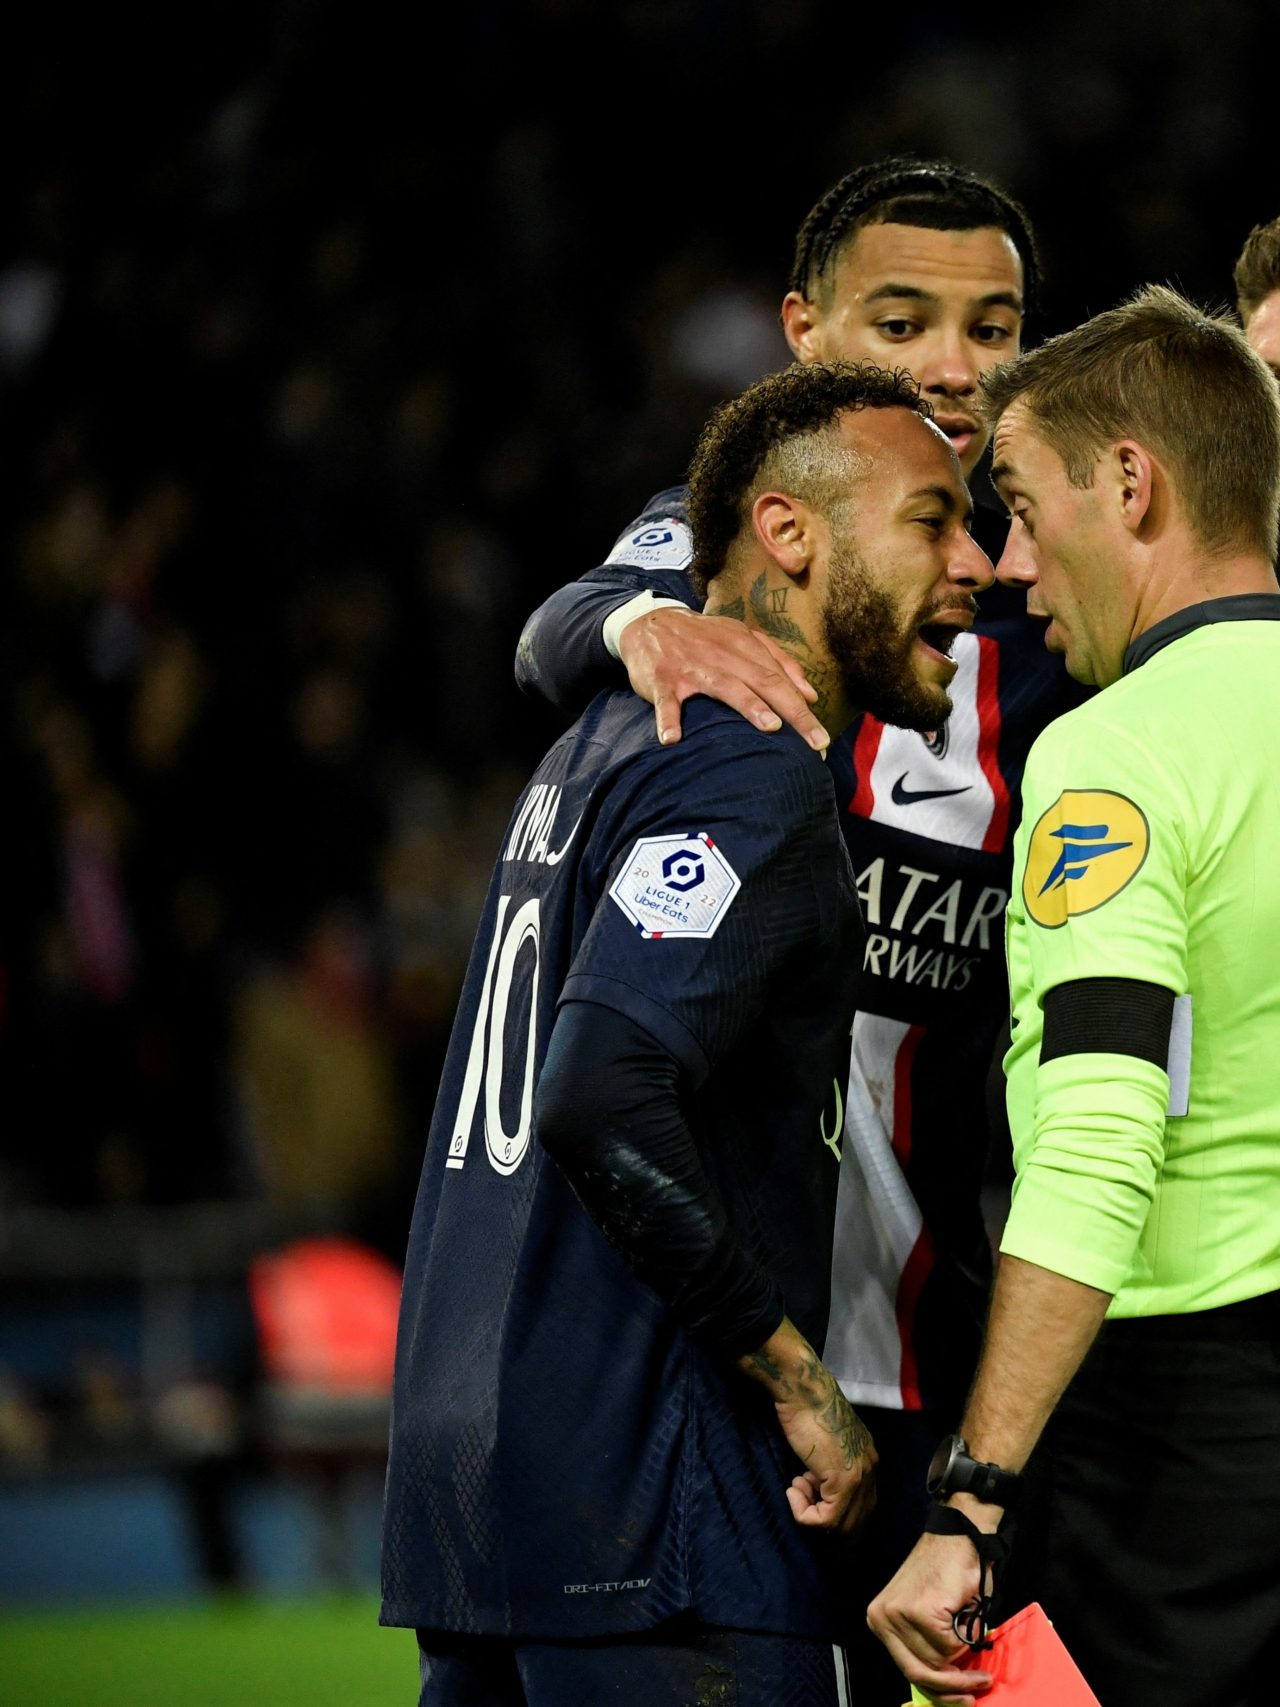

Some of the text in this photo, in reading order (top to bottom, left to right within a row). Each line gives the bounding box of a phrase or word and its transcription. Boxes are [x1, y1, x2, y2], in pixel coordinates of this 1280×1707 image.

[633, 867, 650, 878] 20
[634, 893, 689, 923] Uber Eats
[645, 886, 690, 910] LIGUE 1
[700, 894, 717, 907] 22
[855, 856, 1008, 950] ATAR
[863, 933, 982, 992] RWAYS
[446, 895, 541, 1176] 10
